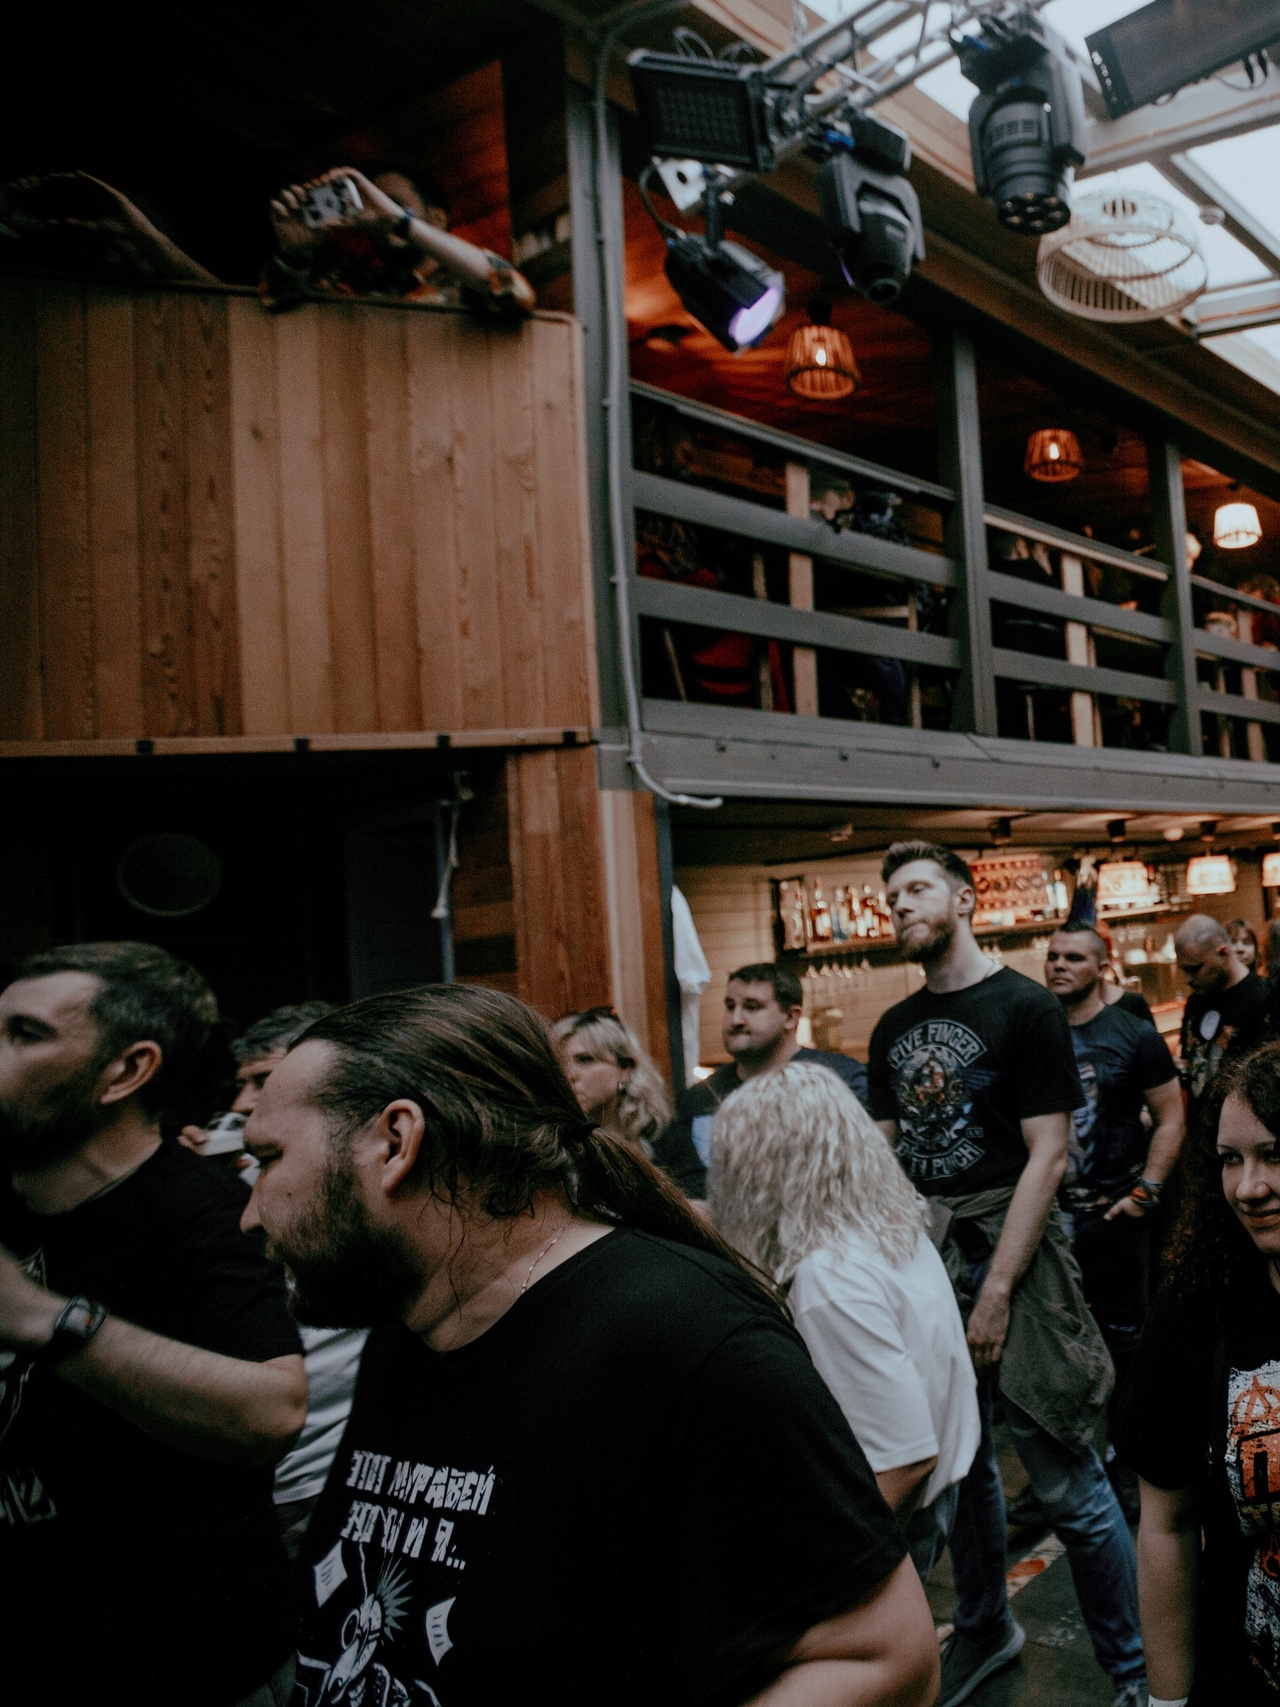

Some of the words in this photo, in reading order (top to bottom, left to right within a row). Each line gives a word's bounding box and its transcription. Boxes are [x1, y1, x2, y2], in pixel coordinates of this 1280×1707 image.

[928, 1023, 980, 1061] FINGER
[387, 1461, 496, 1515] МУРАВЕЙ
[402, 1516, 428, 1558] И
